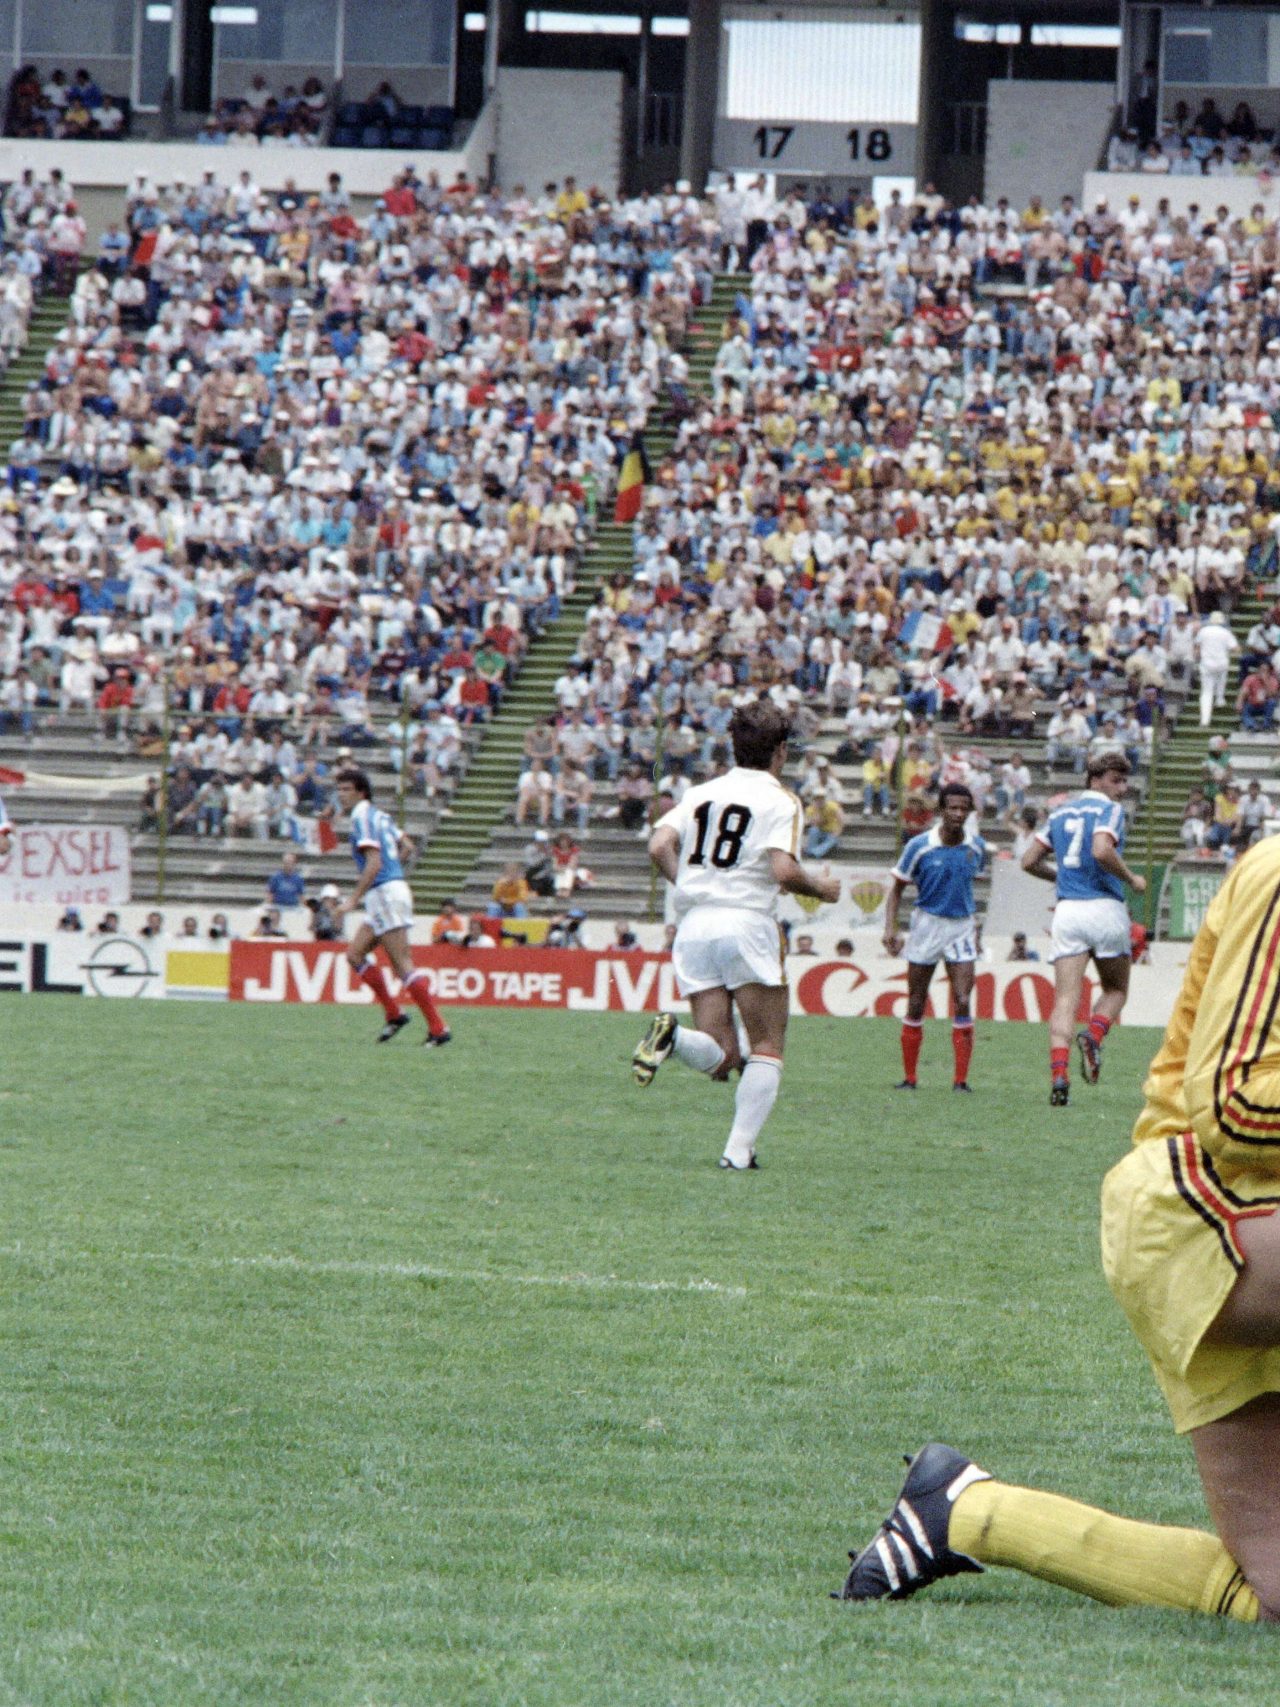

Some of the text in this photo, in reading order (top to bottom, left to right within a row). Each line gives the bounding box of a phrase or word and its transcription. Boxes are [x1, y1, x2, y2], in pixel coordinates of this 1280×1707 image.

[753, 126, 892, 161] 17 18
[688, 801, 753, 868] 18
[1063, 817, 1085, 869] 7
[951, 938, 973, 960] 14
[243, 950, 376, 1002] JVC
[489, 972, 563, 1001] TAPE
